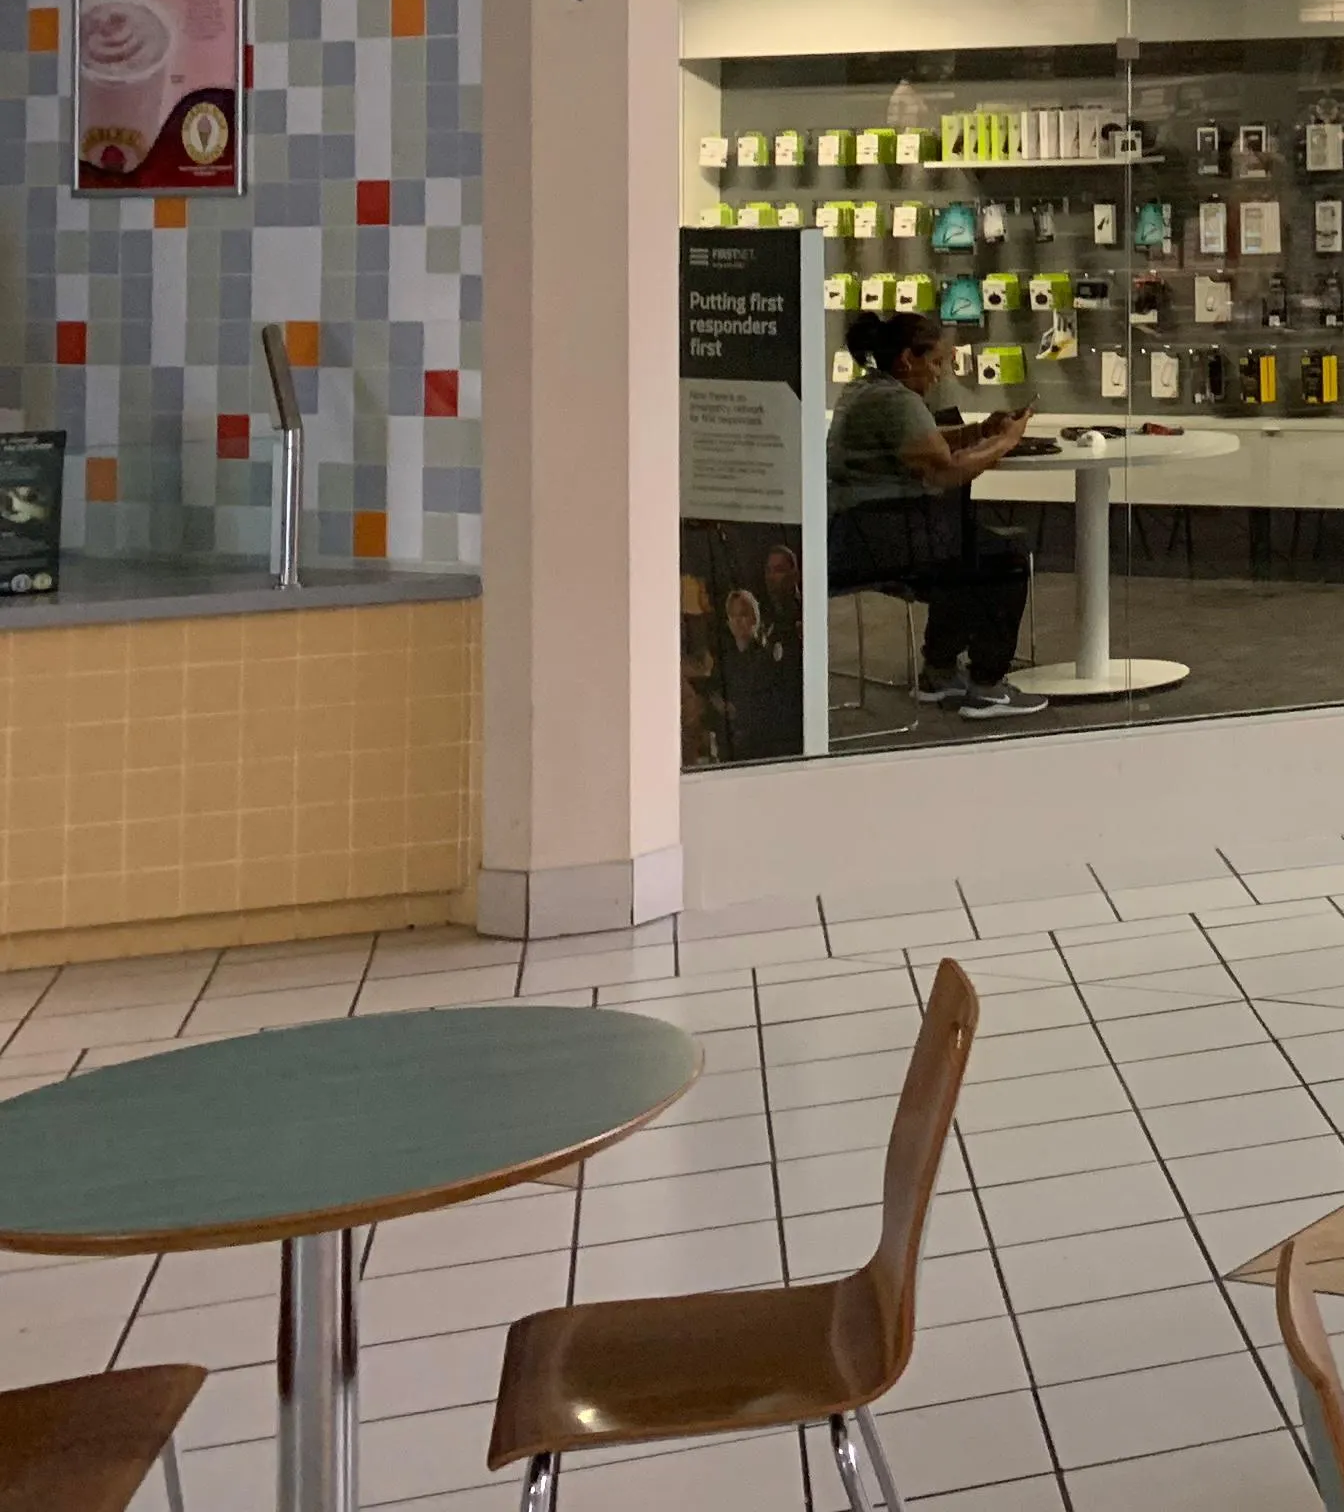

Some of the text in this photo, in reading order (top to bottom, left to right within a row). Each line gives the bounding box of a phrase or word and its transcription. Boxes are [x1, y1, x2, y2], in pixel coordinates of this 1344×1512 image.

[690, 291, 784, 315] Putting first
[689, 315, 777, 337] responders
[690, 337, 722, 357] first
